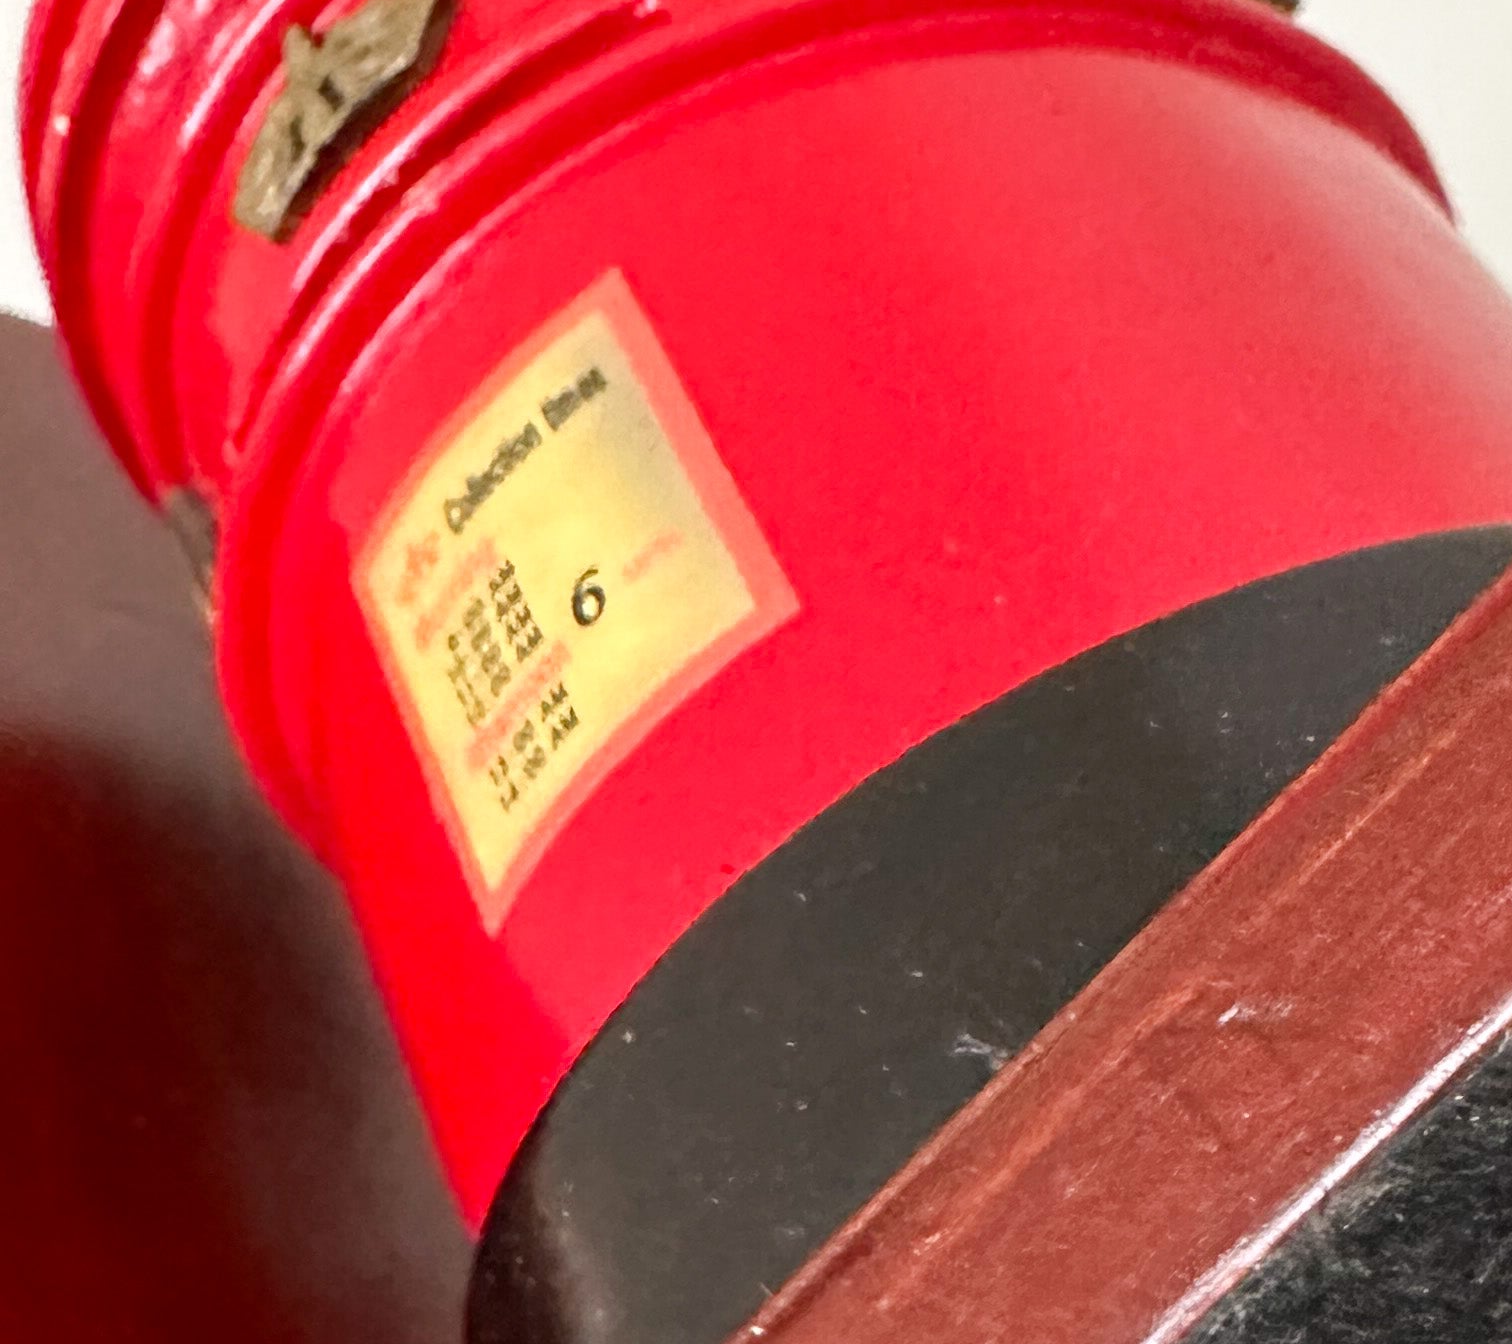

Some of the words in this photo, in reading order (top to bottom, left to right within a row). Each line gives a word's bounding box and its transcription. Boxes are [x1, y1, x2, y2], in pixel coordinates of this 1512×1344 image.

[571, 566, 607, 628] 6
[541, 682, 569, 723] AM
[551, 706, 580, 751] AM
